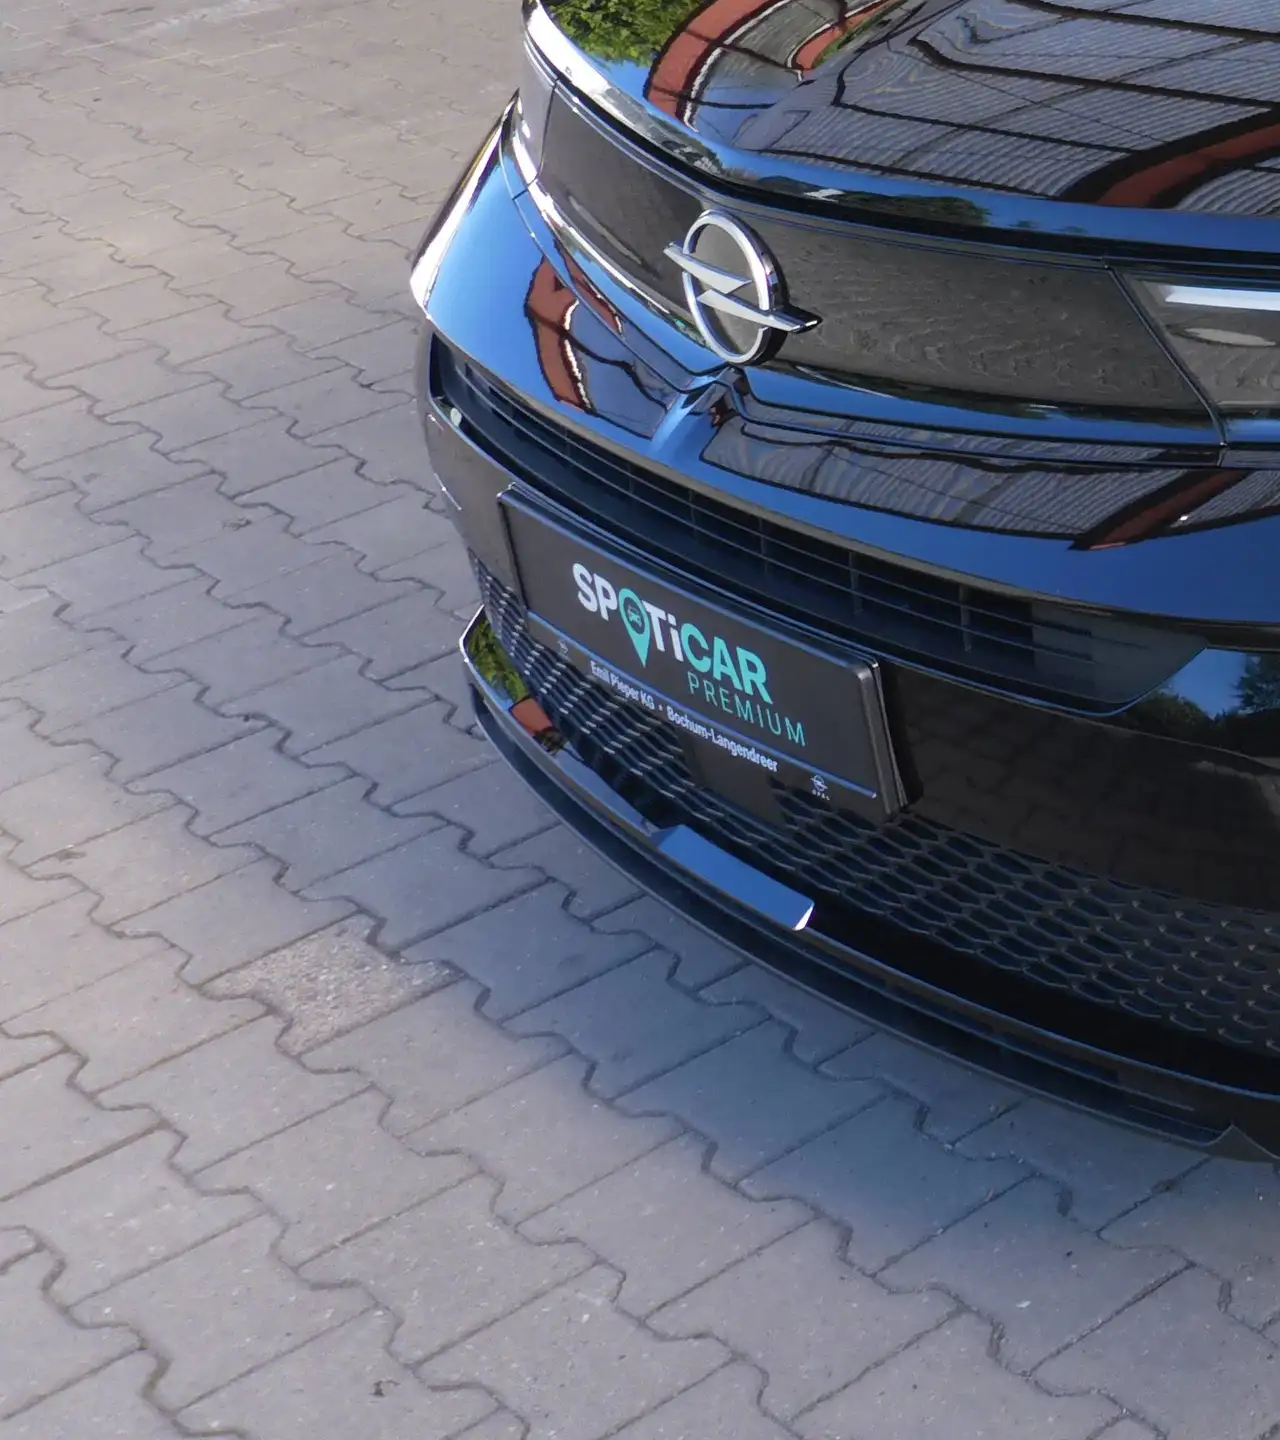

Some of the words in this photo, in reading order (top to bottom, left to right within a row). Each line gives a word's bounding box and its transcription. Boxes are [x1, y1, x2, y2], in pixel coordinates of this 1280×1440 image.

[640, 689, 655, 710] KG
[666, 705, 779, 772] Bochum-Langendreer
[687, 671, 806, 747] PREMIUM
